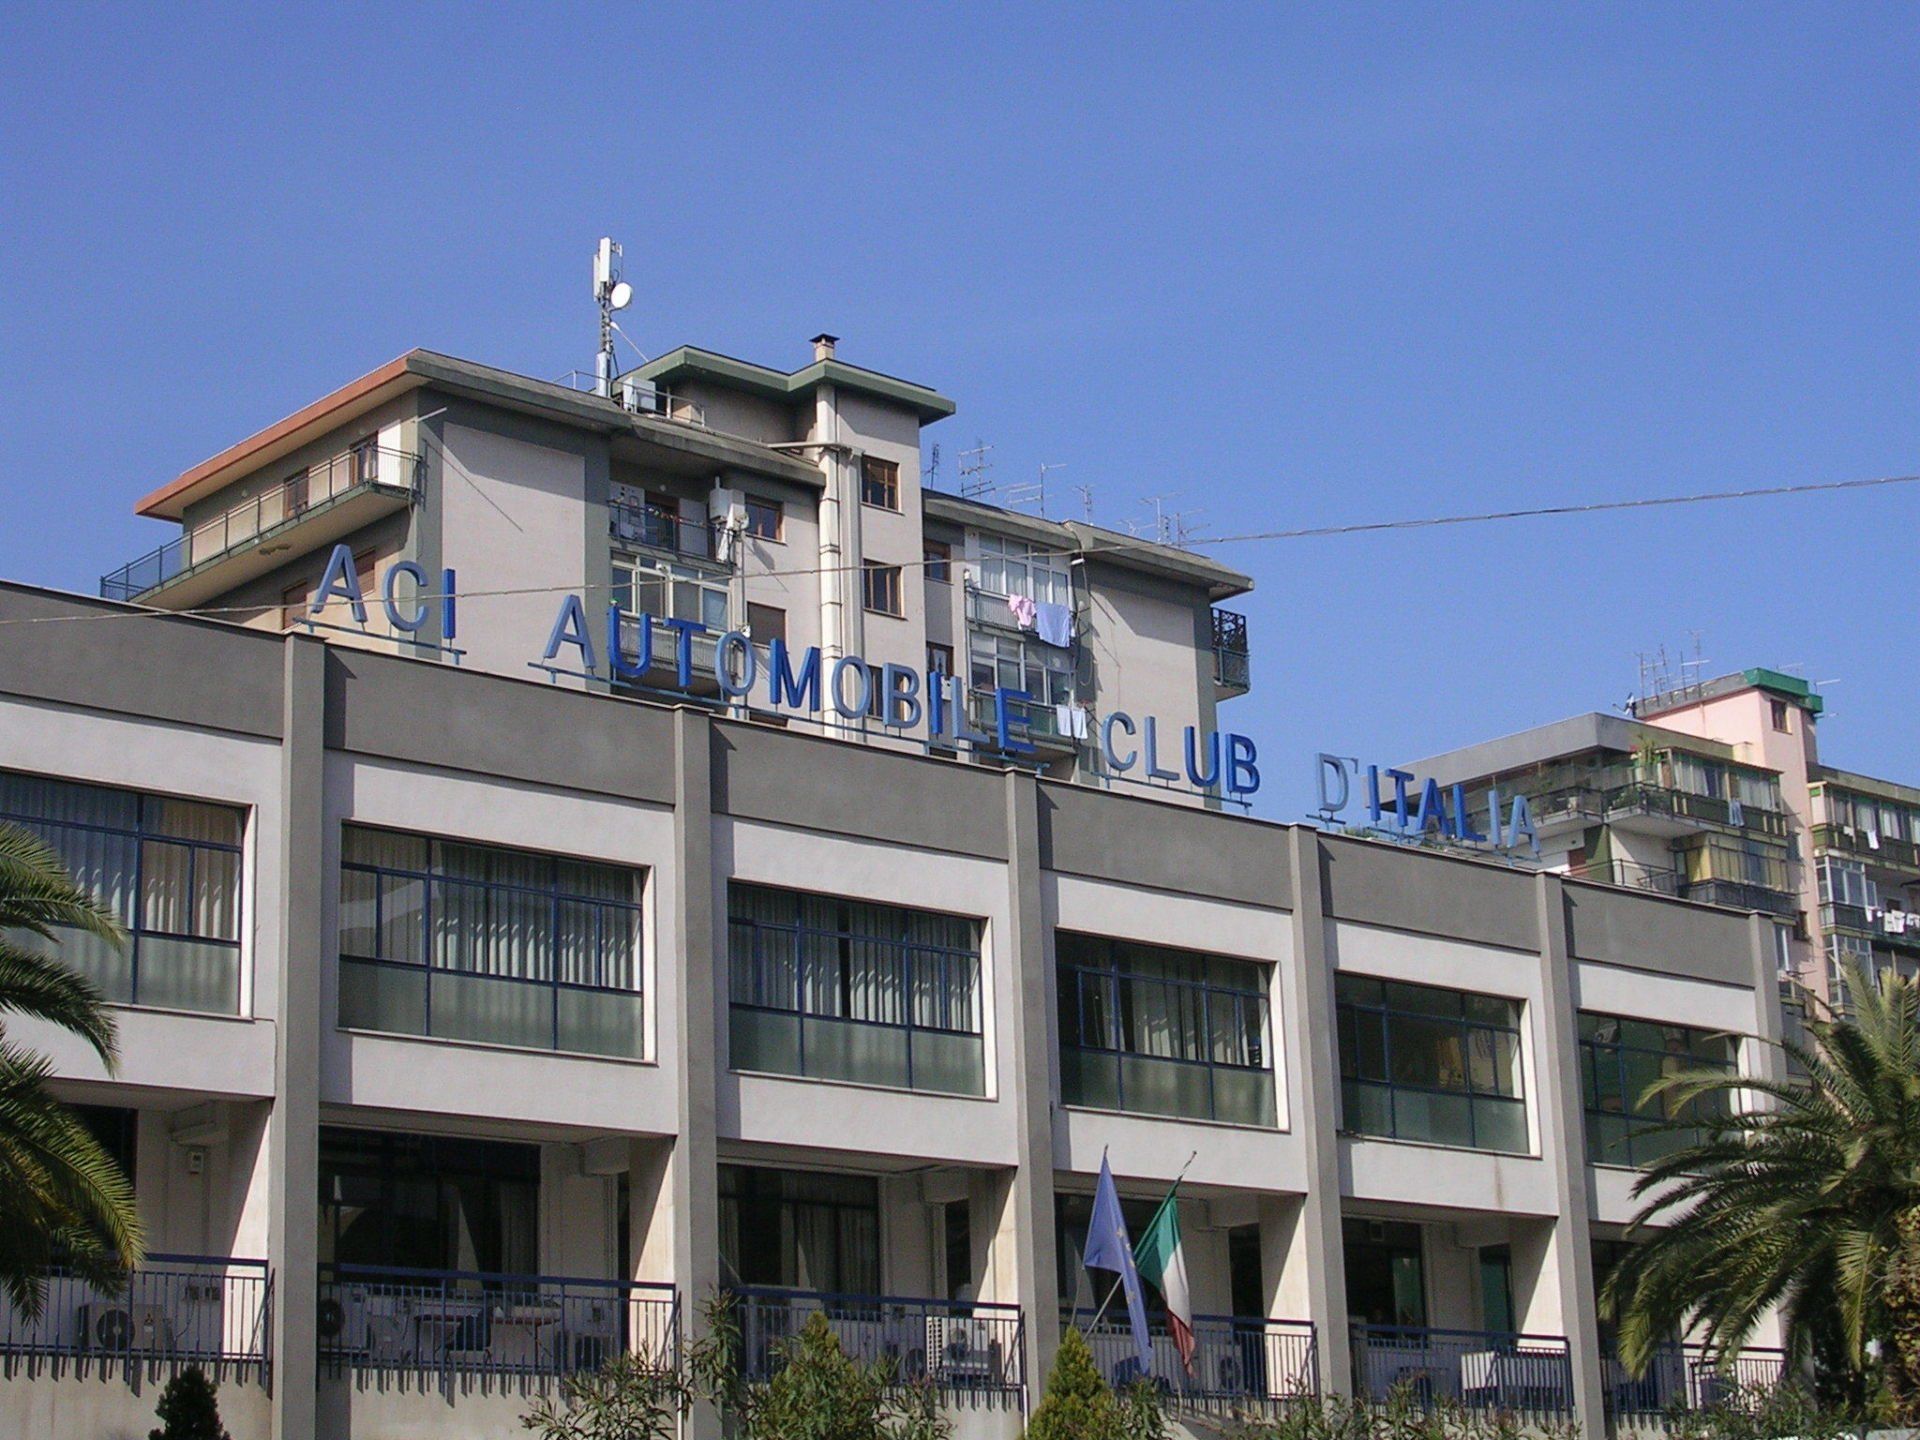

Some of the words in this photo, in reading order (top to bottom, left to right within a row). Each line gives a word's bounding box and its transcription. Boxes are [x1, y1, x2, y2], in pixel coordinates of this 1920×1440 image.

[311, 544, 456, 639] ACI
[544, 594, 1037, 754] AUTOMOBILE
[1102, 711, 1261, 795] CLUB
[1315, 752, 1541, 854] D'ITALIA
